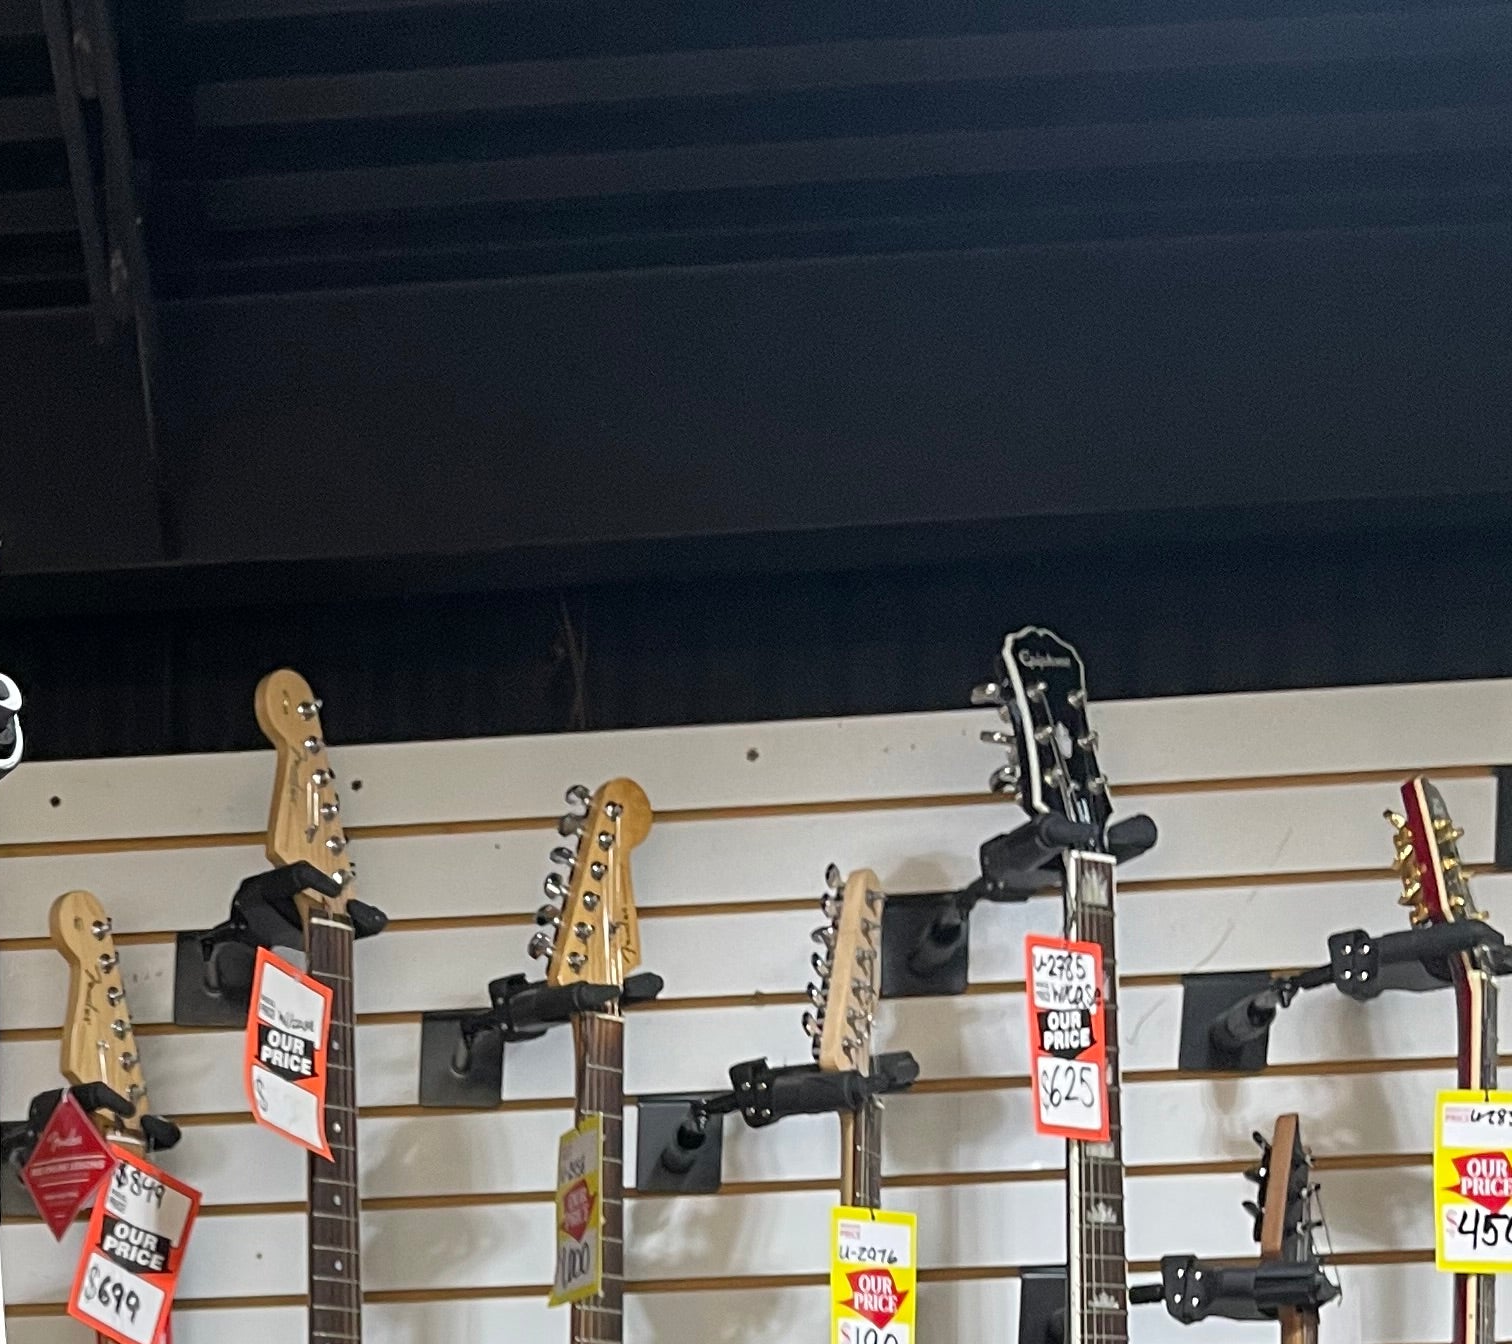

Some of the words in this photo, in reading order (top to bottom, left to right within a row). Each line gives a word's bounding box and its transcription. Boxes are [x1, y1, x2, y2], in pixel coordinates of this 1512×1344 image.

[1047, 1011, 1083, 1032] OUR
[266, 1029, 306, 1056] OUR
[1043, 1027, 1091, 1051] PRICE
[260, 1045, 313, 1076] PRICE
[1042, 1064, 1095, 1111] $625
[1466, 1157, 1508, 1178] OUR
[113, 1222, 159, 1252] OUR
[102, 1235, 166, 1273] PRICE
[84, 1263, 141, 1324] $699
[858, 1273, 893, 1295] OUR
[853, 1291, 899, 1315] PRICE
